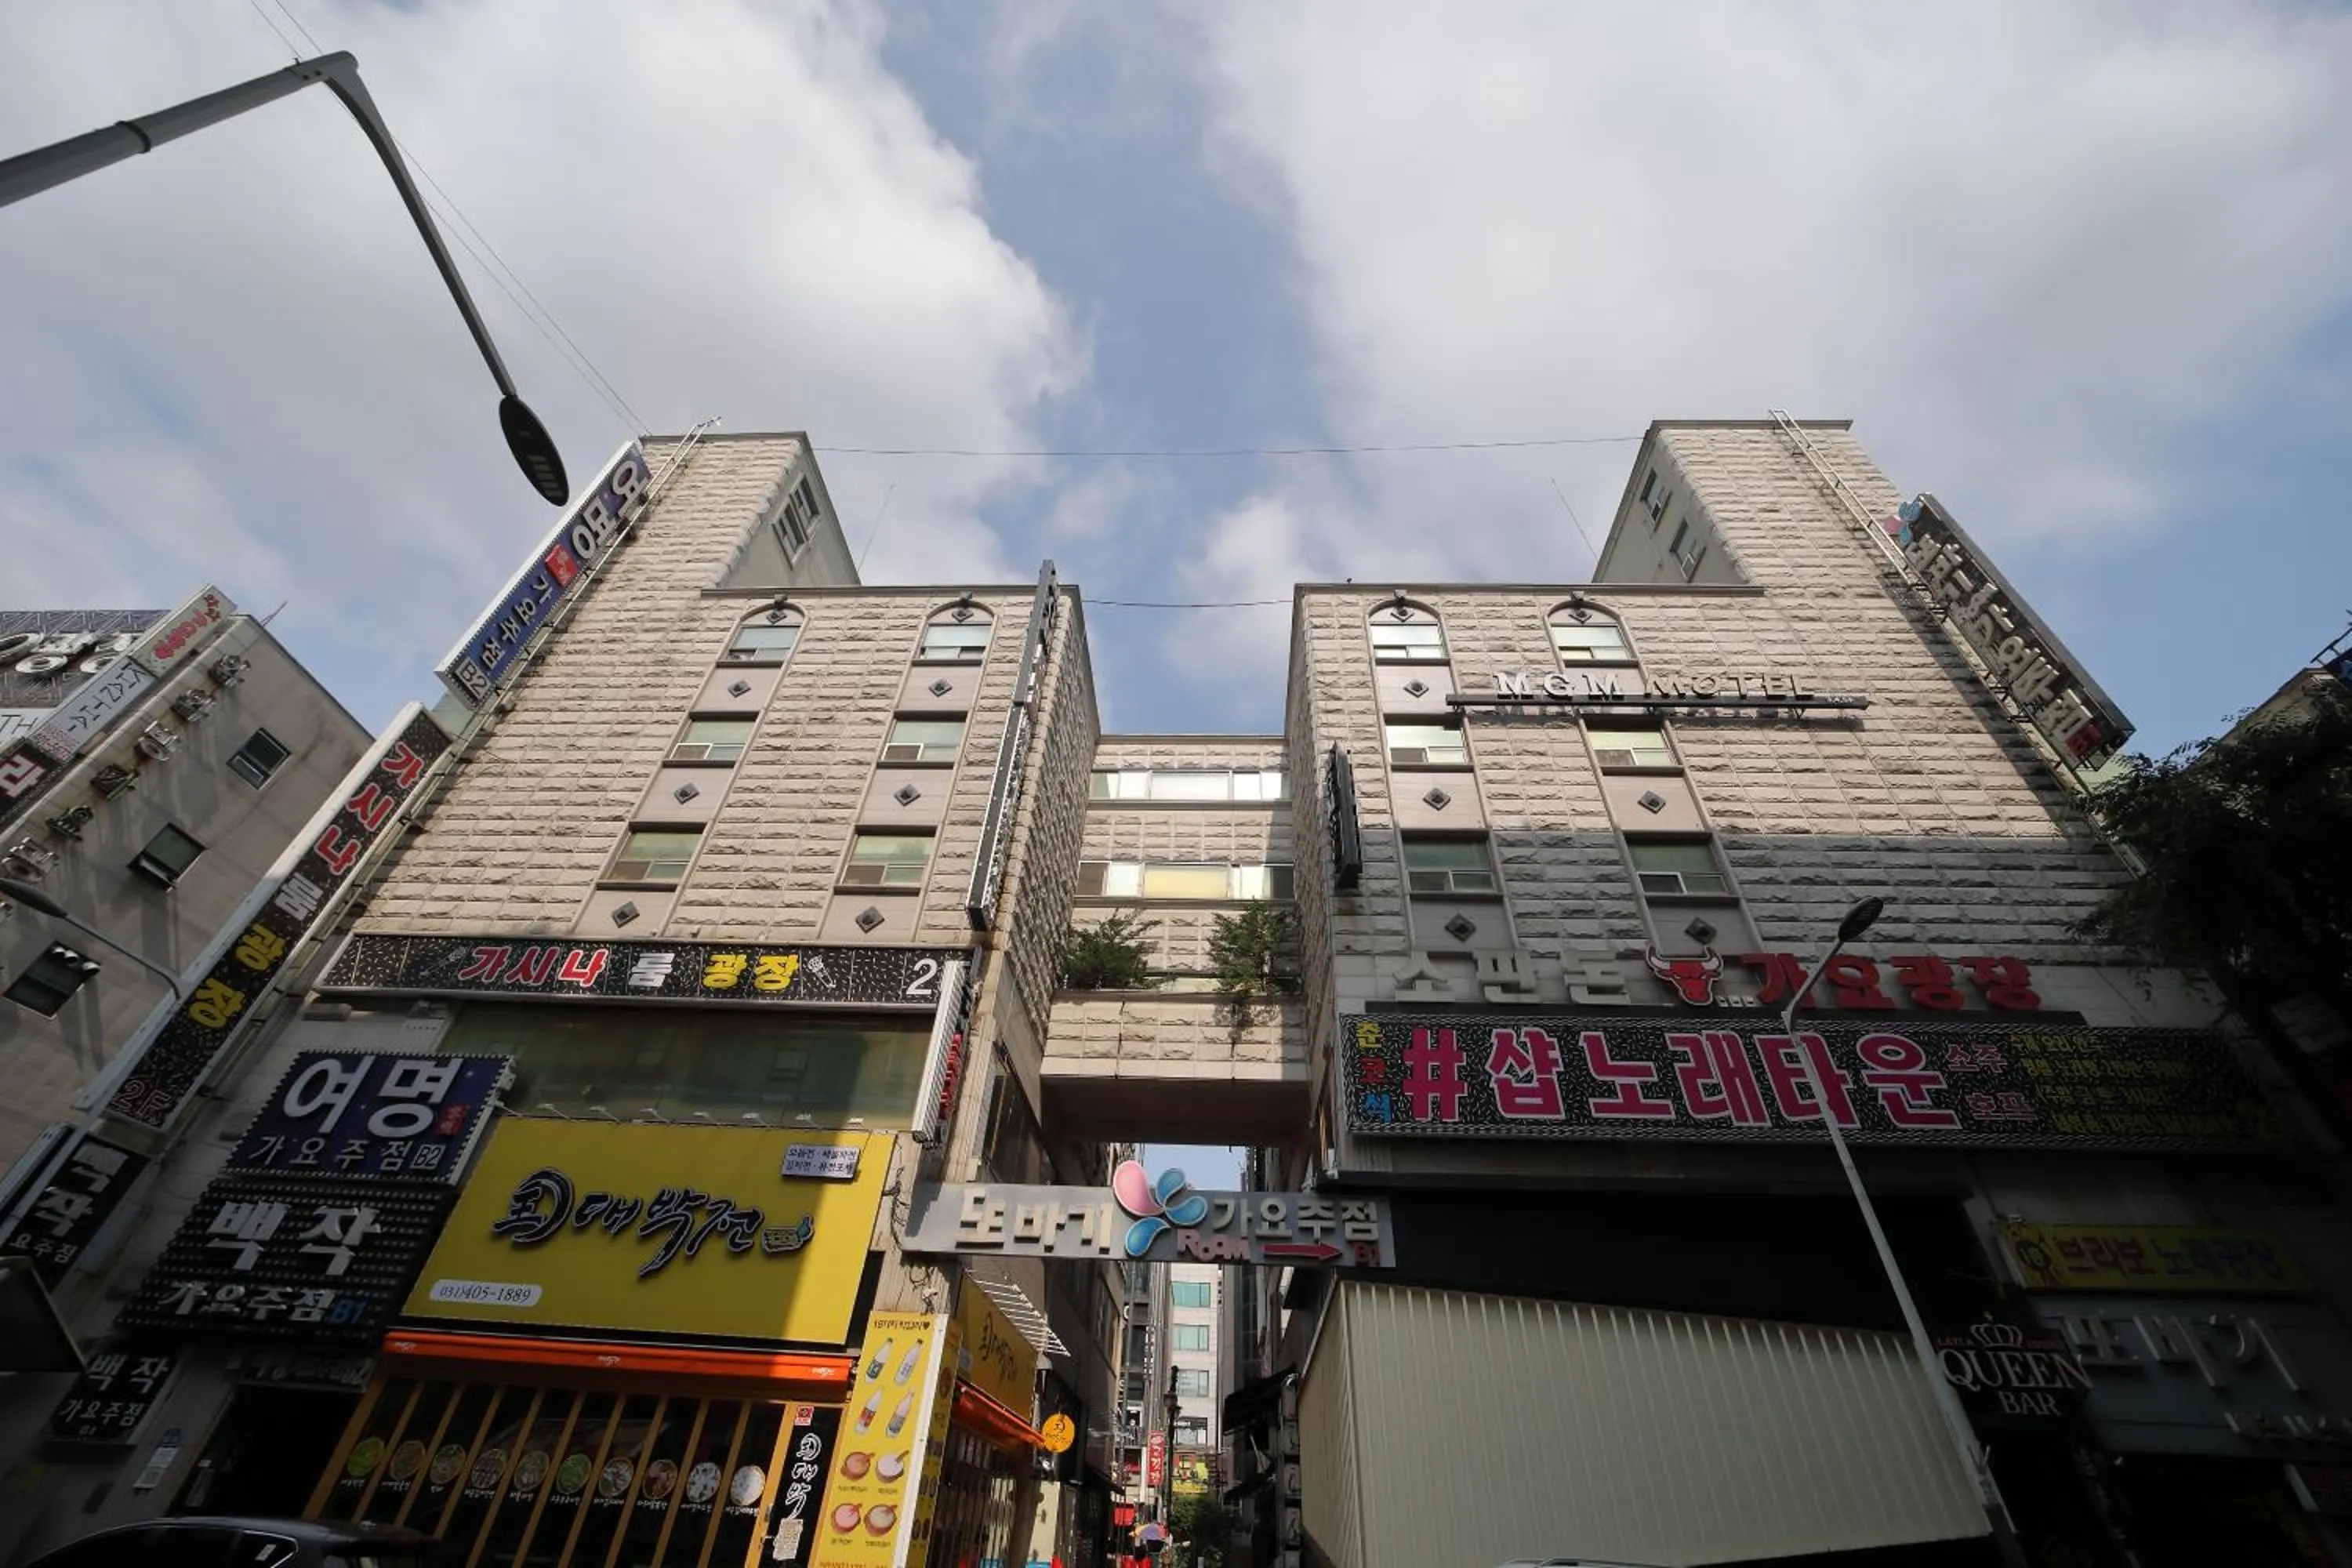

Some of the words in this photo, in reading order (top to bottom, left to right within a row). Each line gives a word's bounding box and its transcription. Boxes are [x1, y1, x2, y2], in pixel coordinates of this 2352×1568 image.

[572, 459, 652, 560] 여명
[481, 576, 554, 670] 가요주점
[457, 659, 491, 700] B2
[1646, 673, 1814, 700] MOTEL
[316, 742, 426, 877] 가시나
[274, 873, 323, 921] 룸
[187, 921, 288, 1029] 광장
[457, 944, 609, 988] 가시나
[629, 953, 676, 988] 룸
[702, 953, 800, 991] 광장
[906, 957, 938, 995] 2
[1739, 953, 2042, 1011] 가요광장
[113, 1077, 173, 1124] 2F
[283, 1055, 465, 1138] 여명
[248, 1134, 413, 1172] 가요주점
[412, 1144, 444, 1170] B2
[206, 1200, 382, 1276] 백작
[1211, 1196, 1380, 1243] 가요주점
[7, 1231, 78, 1265] 요주점
[158, 1281, 336, 1323] 가요주점
[329, 1298, 368, 1325] B1
[87, 1354, 169, 1395] 백작
[1937, 1348, 2095, 1392] QUEEN
[57, 1398, 145, 1427] 가요주점
[1998, 1390, 2063, 1417] BAR
